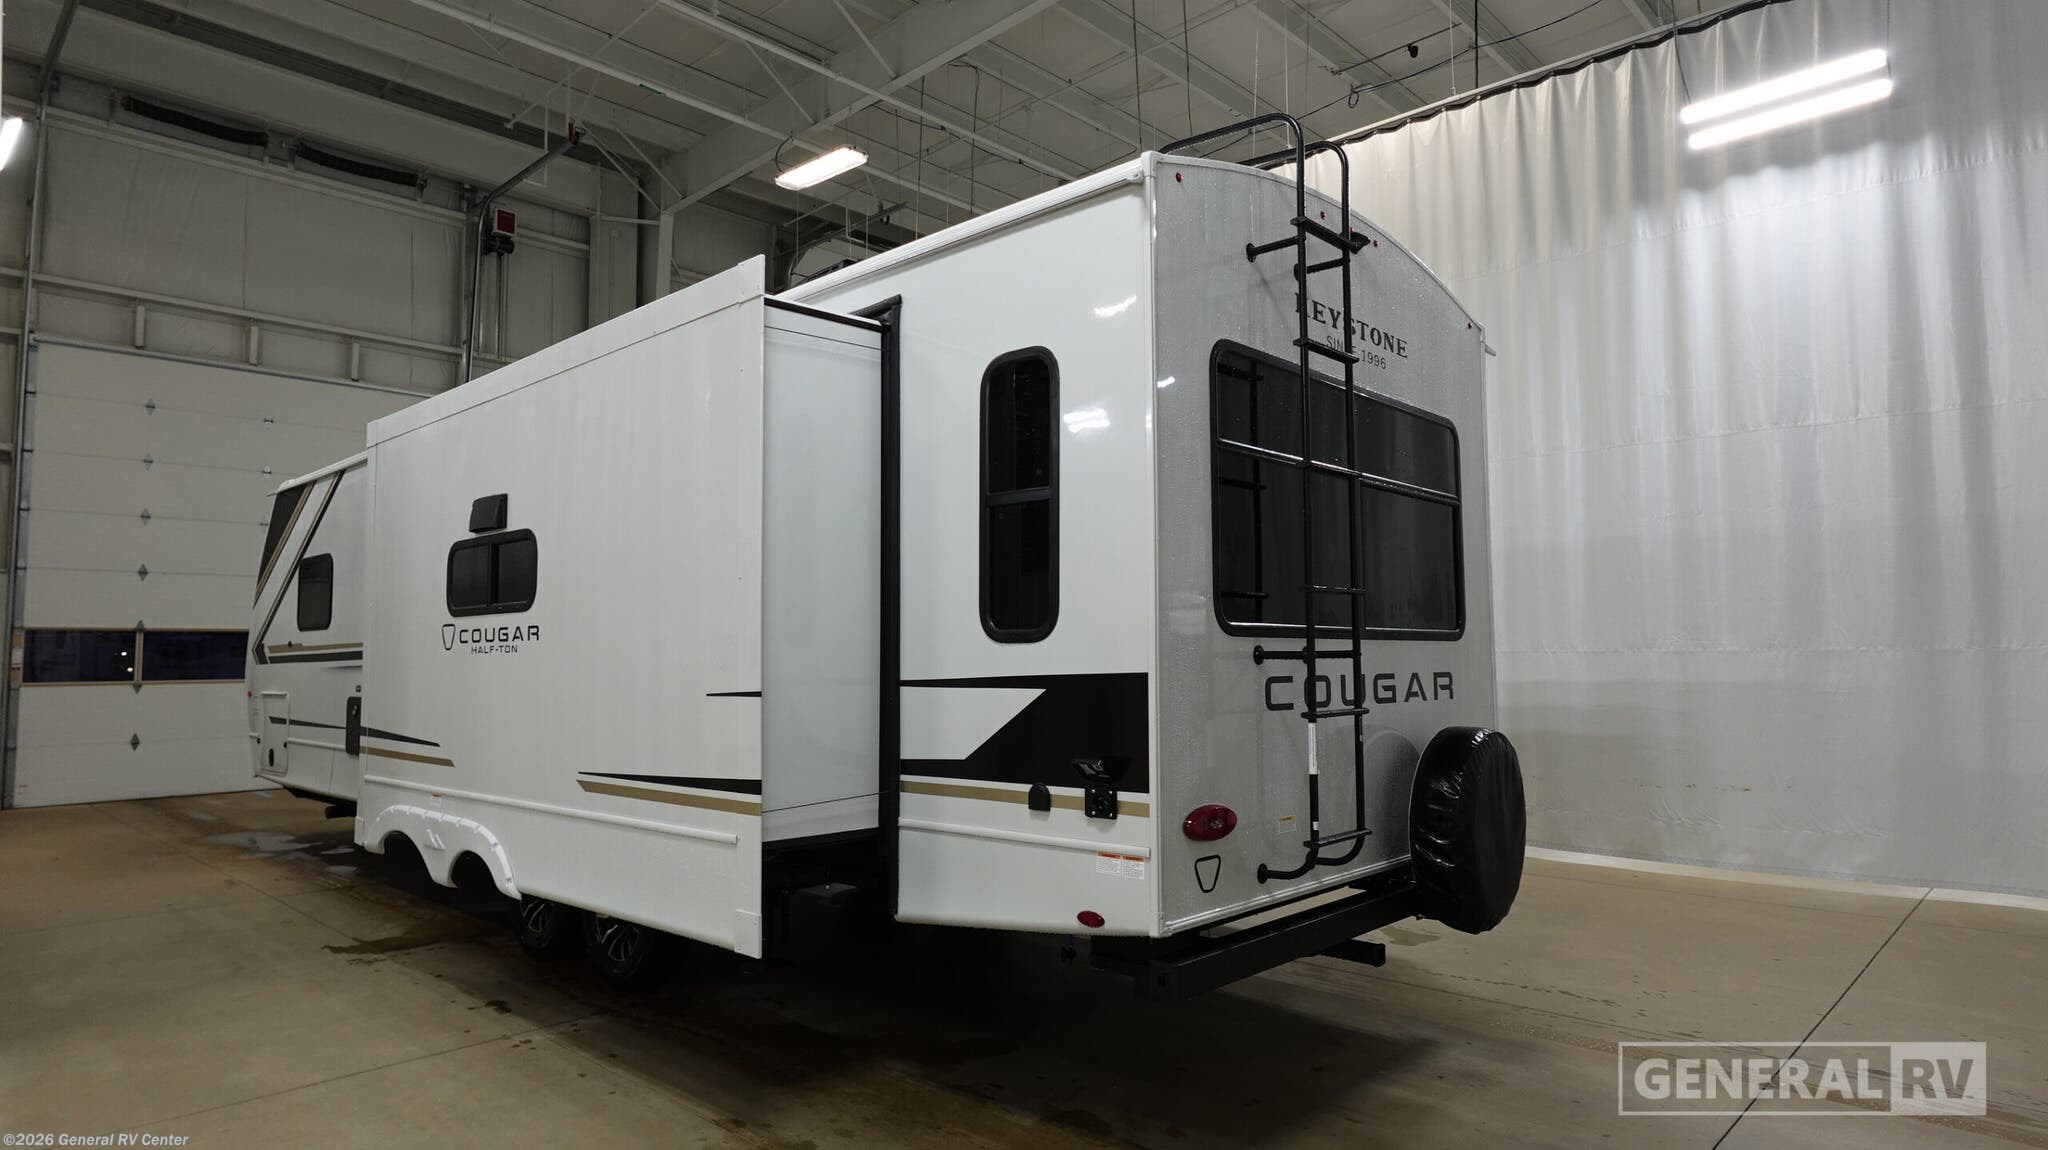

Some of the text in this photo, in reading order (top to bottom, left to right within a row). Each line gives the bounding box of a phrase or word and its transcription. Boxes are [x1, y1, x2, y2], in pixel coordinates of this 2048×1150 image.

[1361, 349, 1387, 370] 1996
[459, 625, 540, 644] COUGAR
[471, 645, 518, 654] HALF-TON
[1265, 672, 1454, 711] COUGAR
